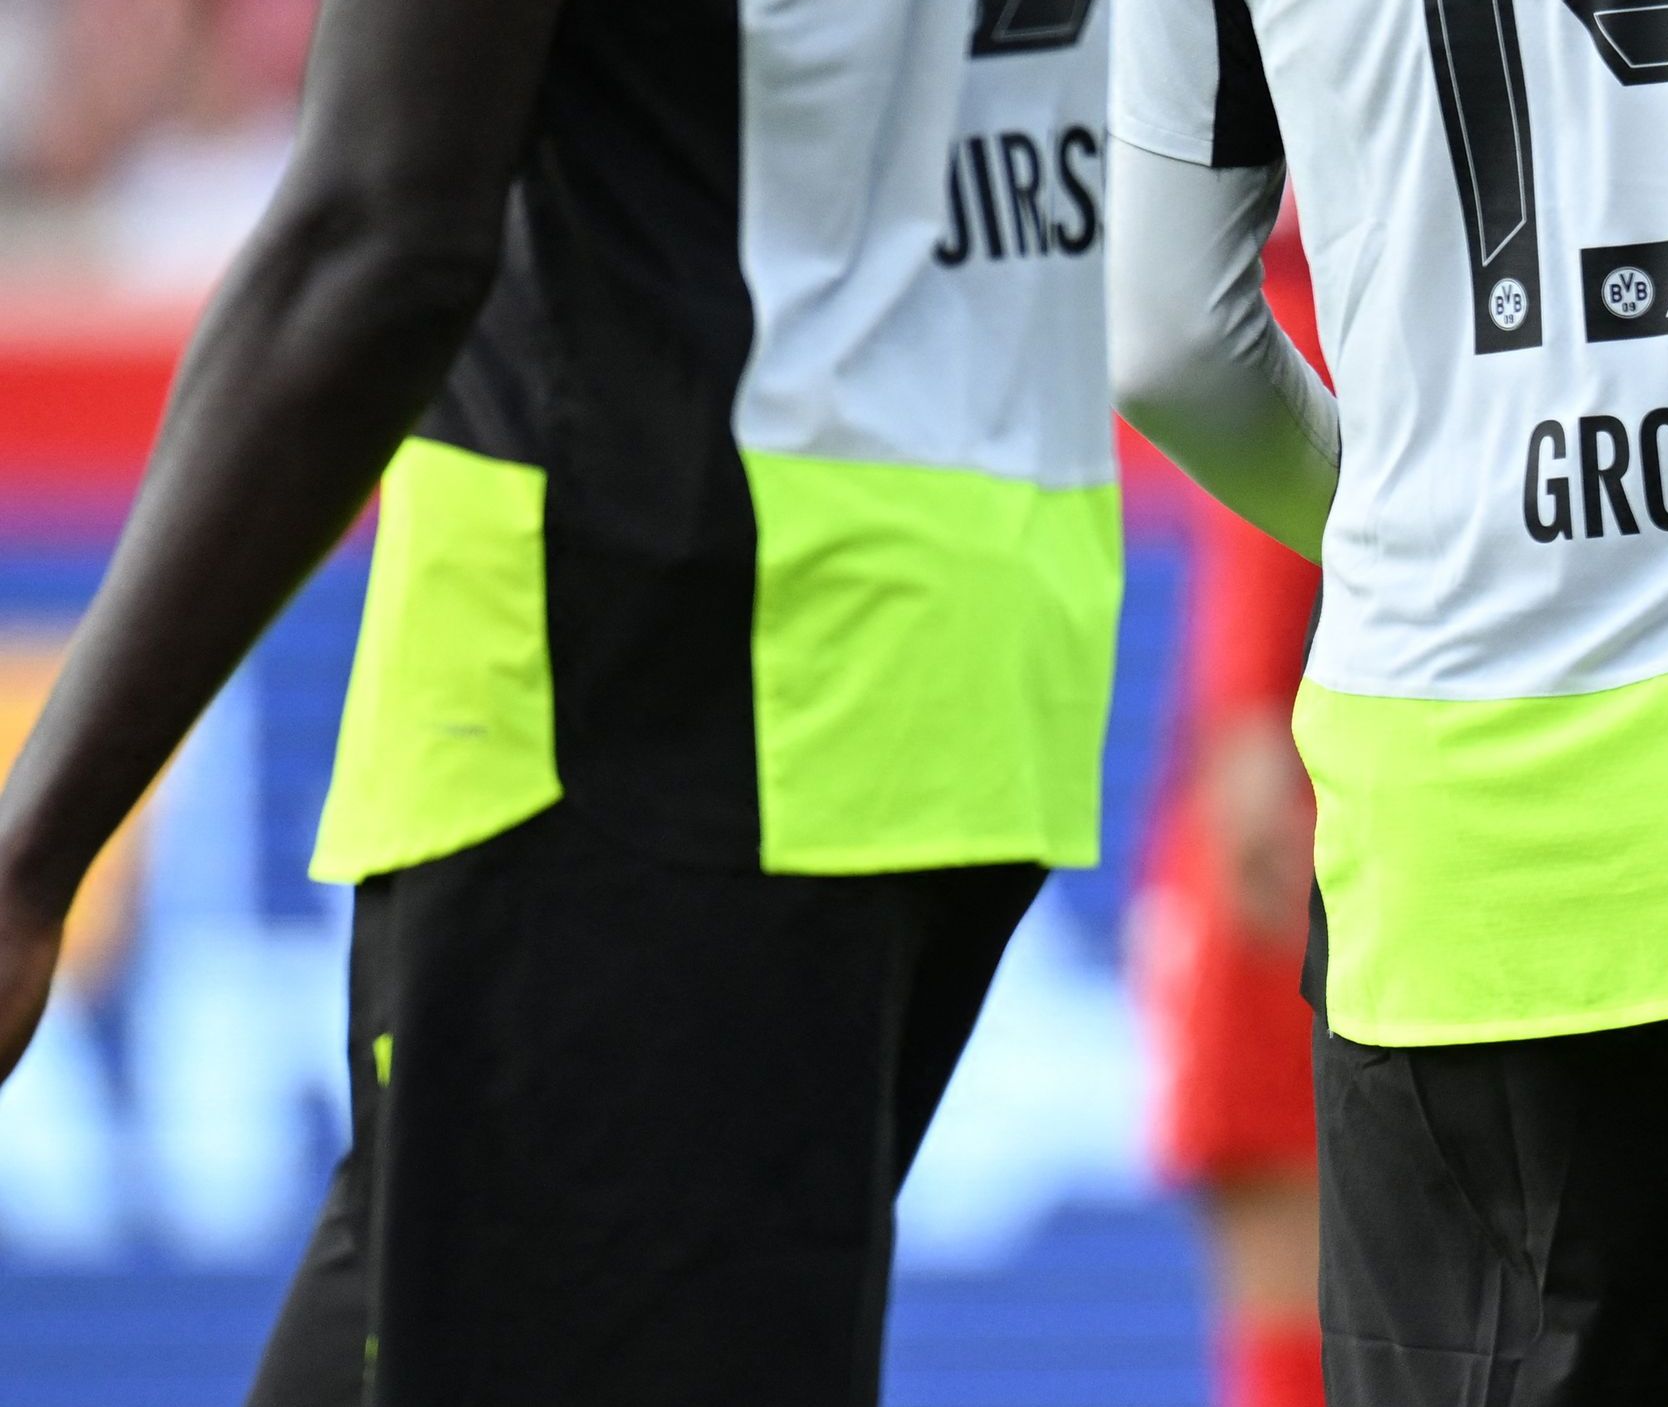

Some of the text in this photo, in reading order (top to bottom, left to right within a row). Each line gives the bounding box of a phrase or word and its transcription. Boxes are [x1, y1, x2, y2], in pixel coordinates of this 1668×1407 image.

[1608, 272, 1649, 304] BVB
[1495, 284, 1523, 315] BVB
[1621, 301, 1637, 313] 09
[1503, 314, 1515, 324] 09
